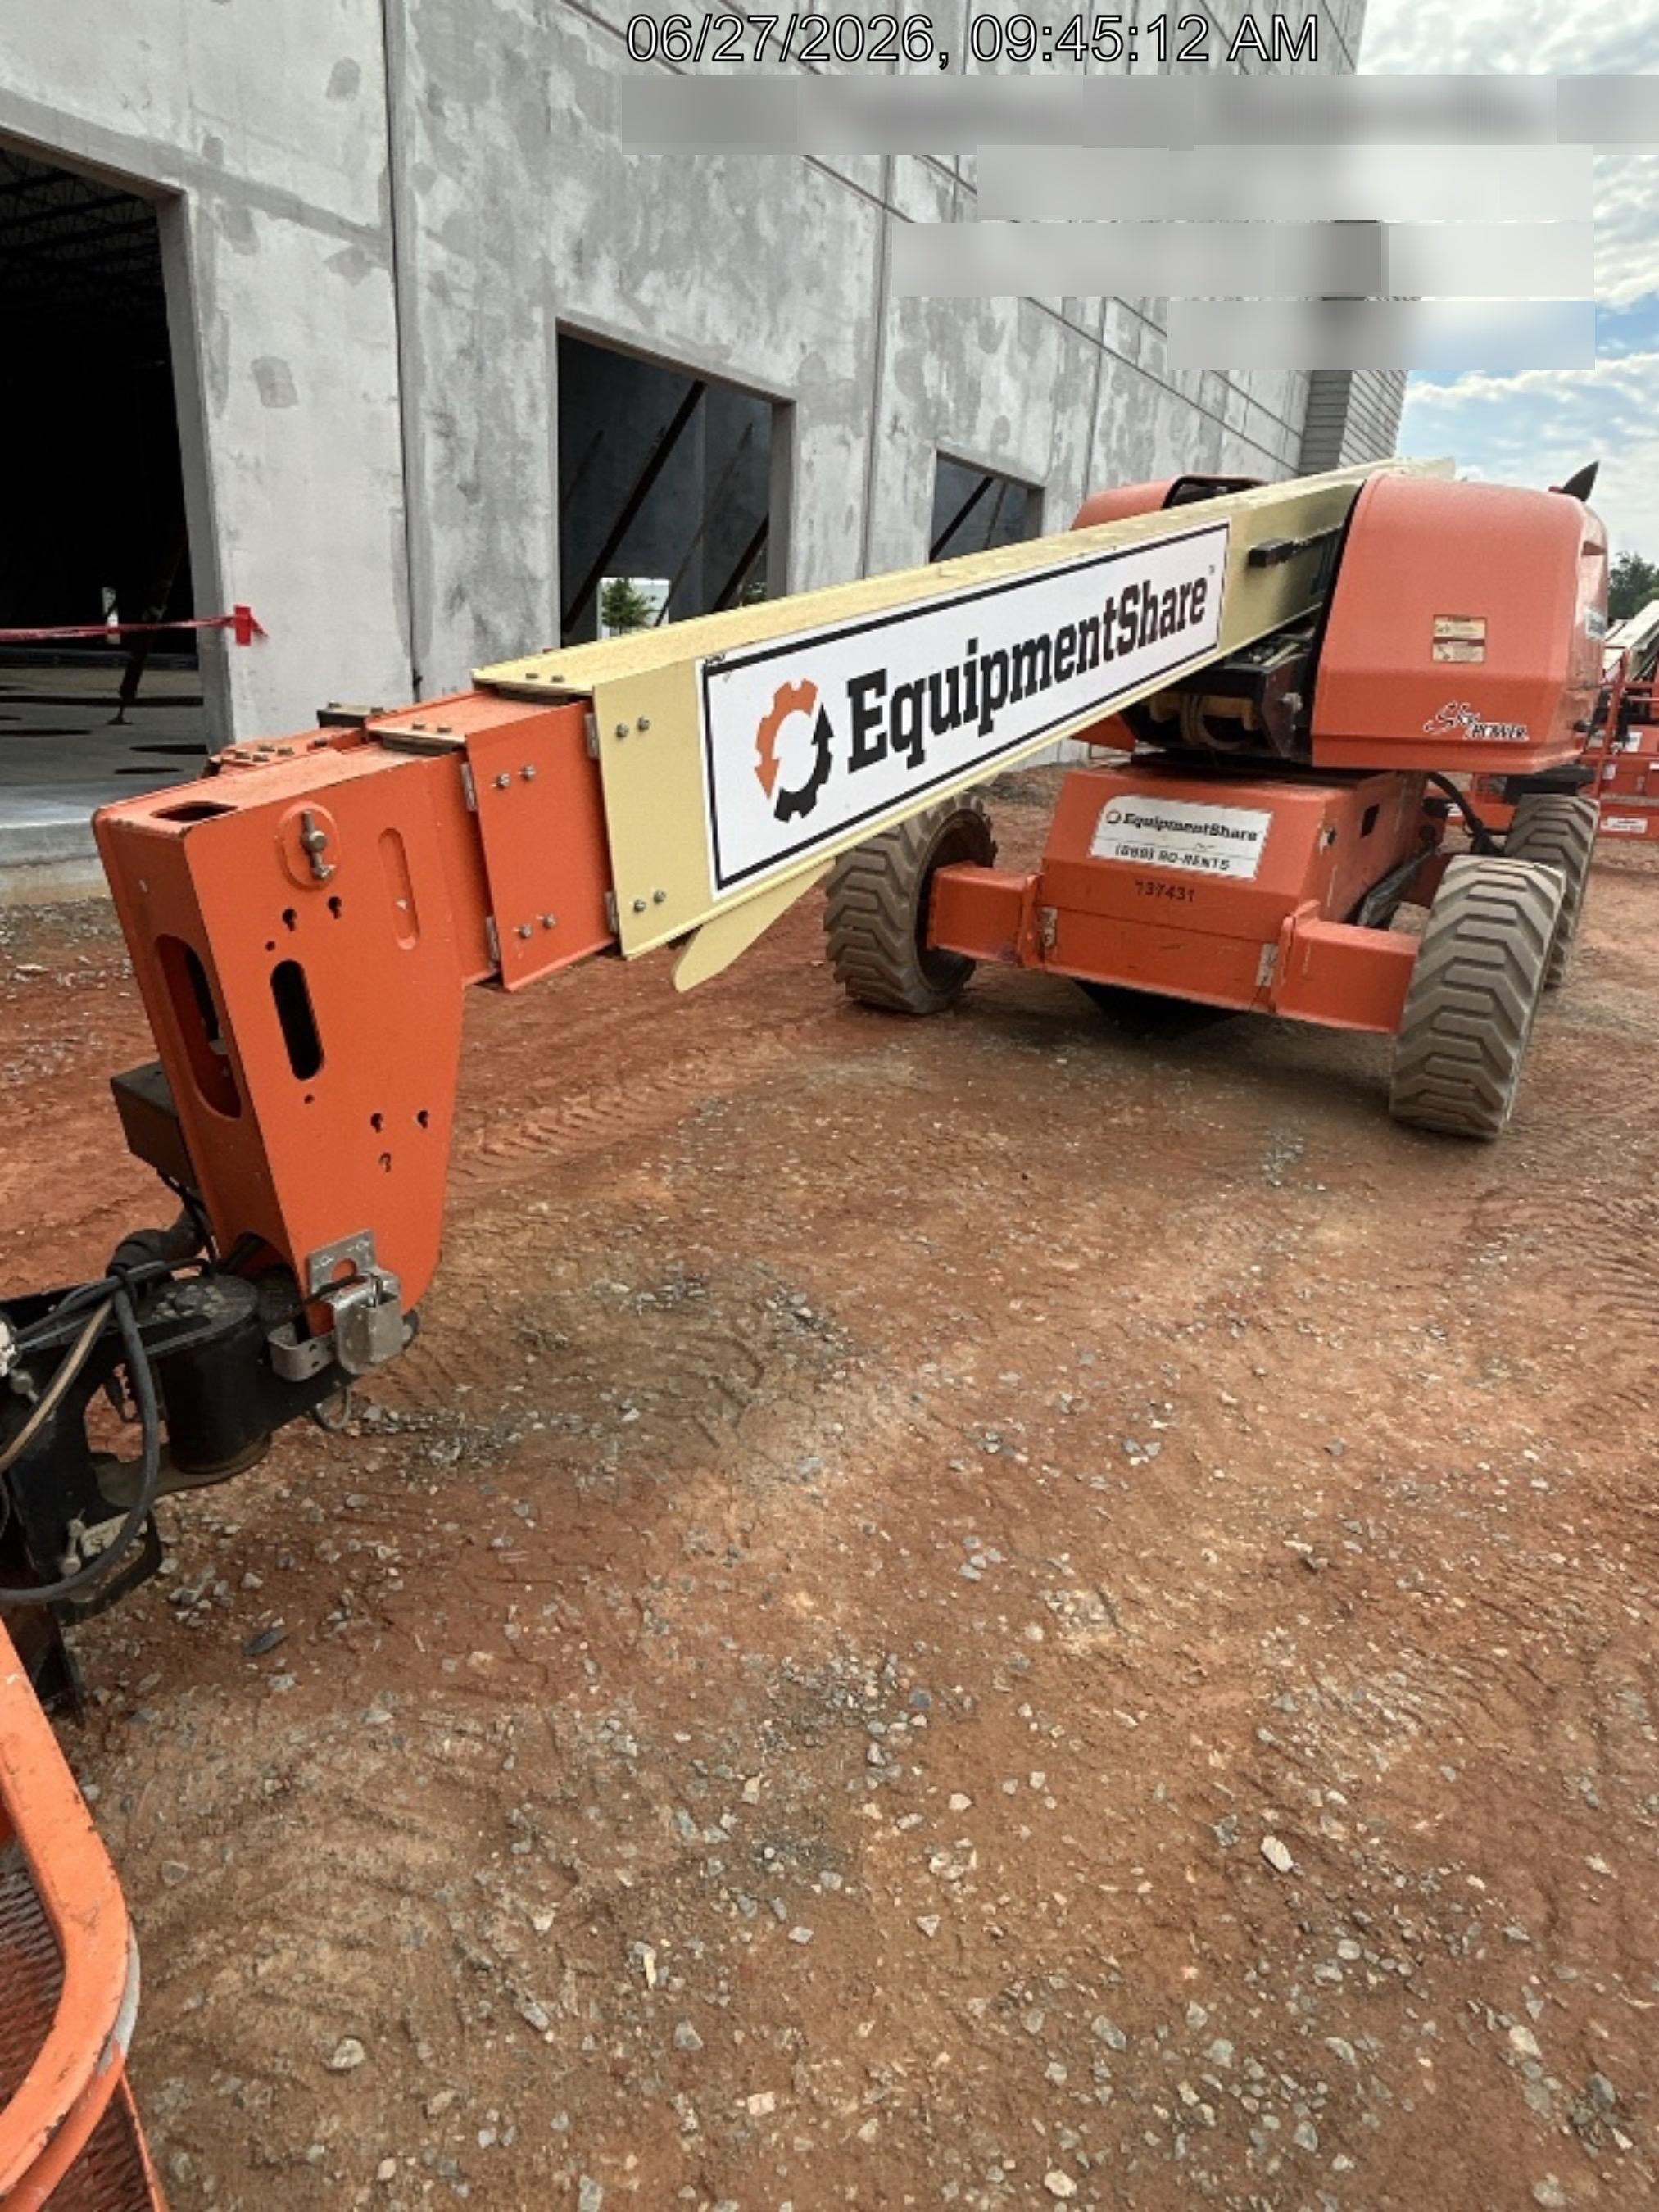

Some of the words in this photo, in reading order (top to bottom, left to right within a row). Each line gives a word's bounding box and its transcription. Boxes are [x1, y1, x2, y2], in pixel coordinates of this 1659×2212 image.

[846, 576, 1207, 773] EquipmentShare
[1123, 813, 1258, 841] EquipmentShare
[1135, 881, 1195, 903] 737431
